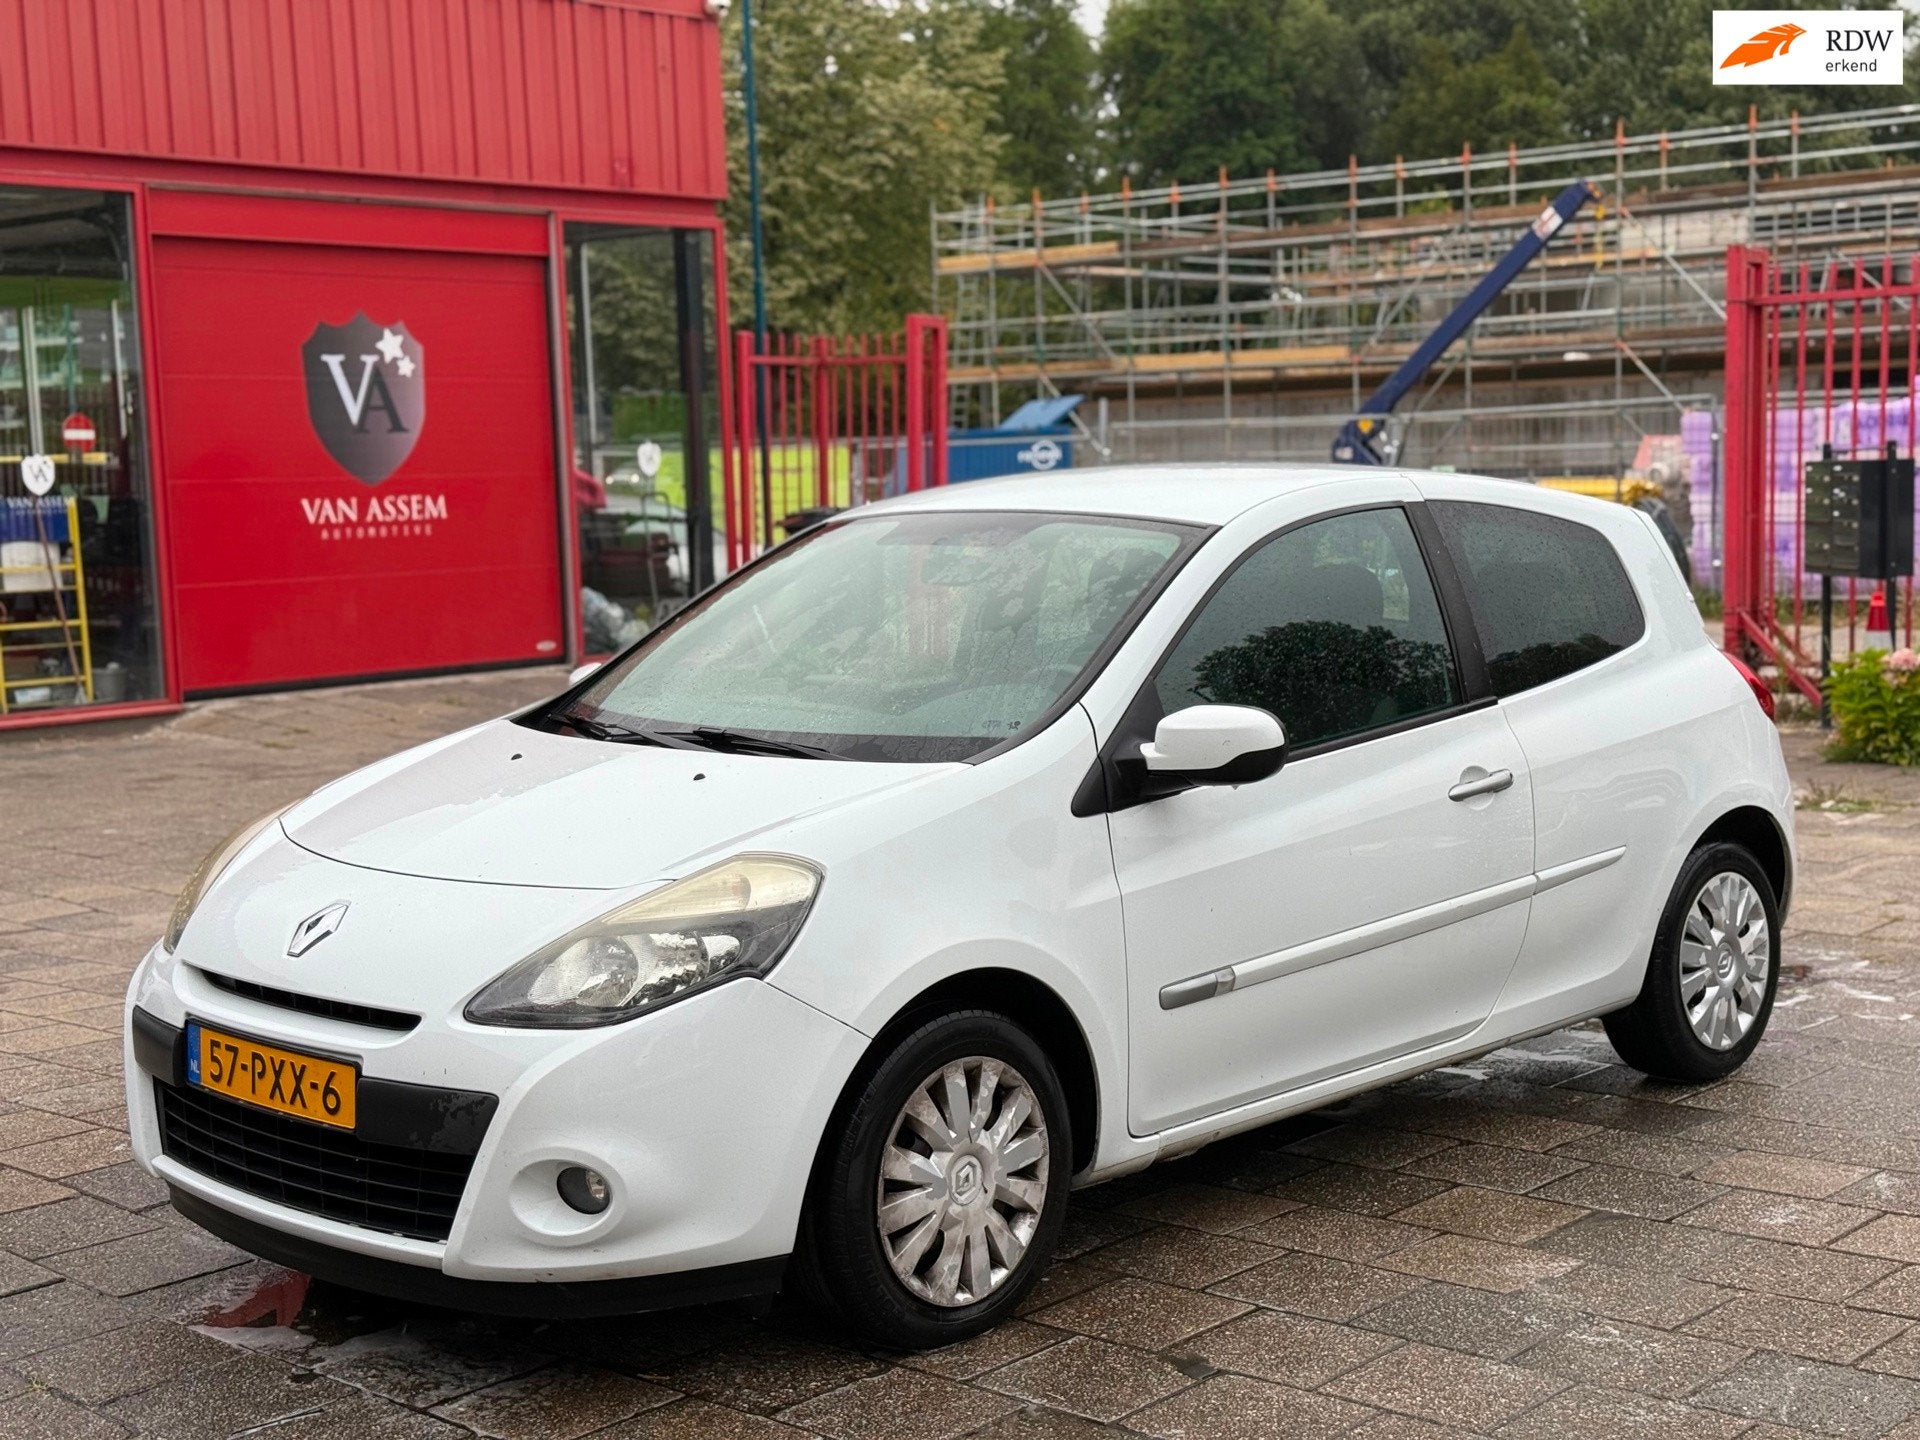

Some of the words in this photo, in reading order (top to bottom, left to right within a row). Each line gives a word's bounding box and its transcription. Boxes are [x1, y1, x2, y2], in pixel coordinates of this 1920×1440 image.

[320, 353, 409, 433] VA
[301, 496, 358, 525] VAN
[366, 494, 448, 523] ASSEM
[320, 524, 433, 541] AUTOMOTIVE
[189, 1058, 200, 1074] NL
[209, 1039, 342, 1116] 57-PXX-6
